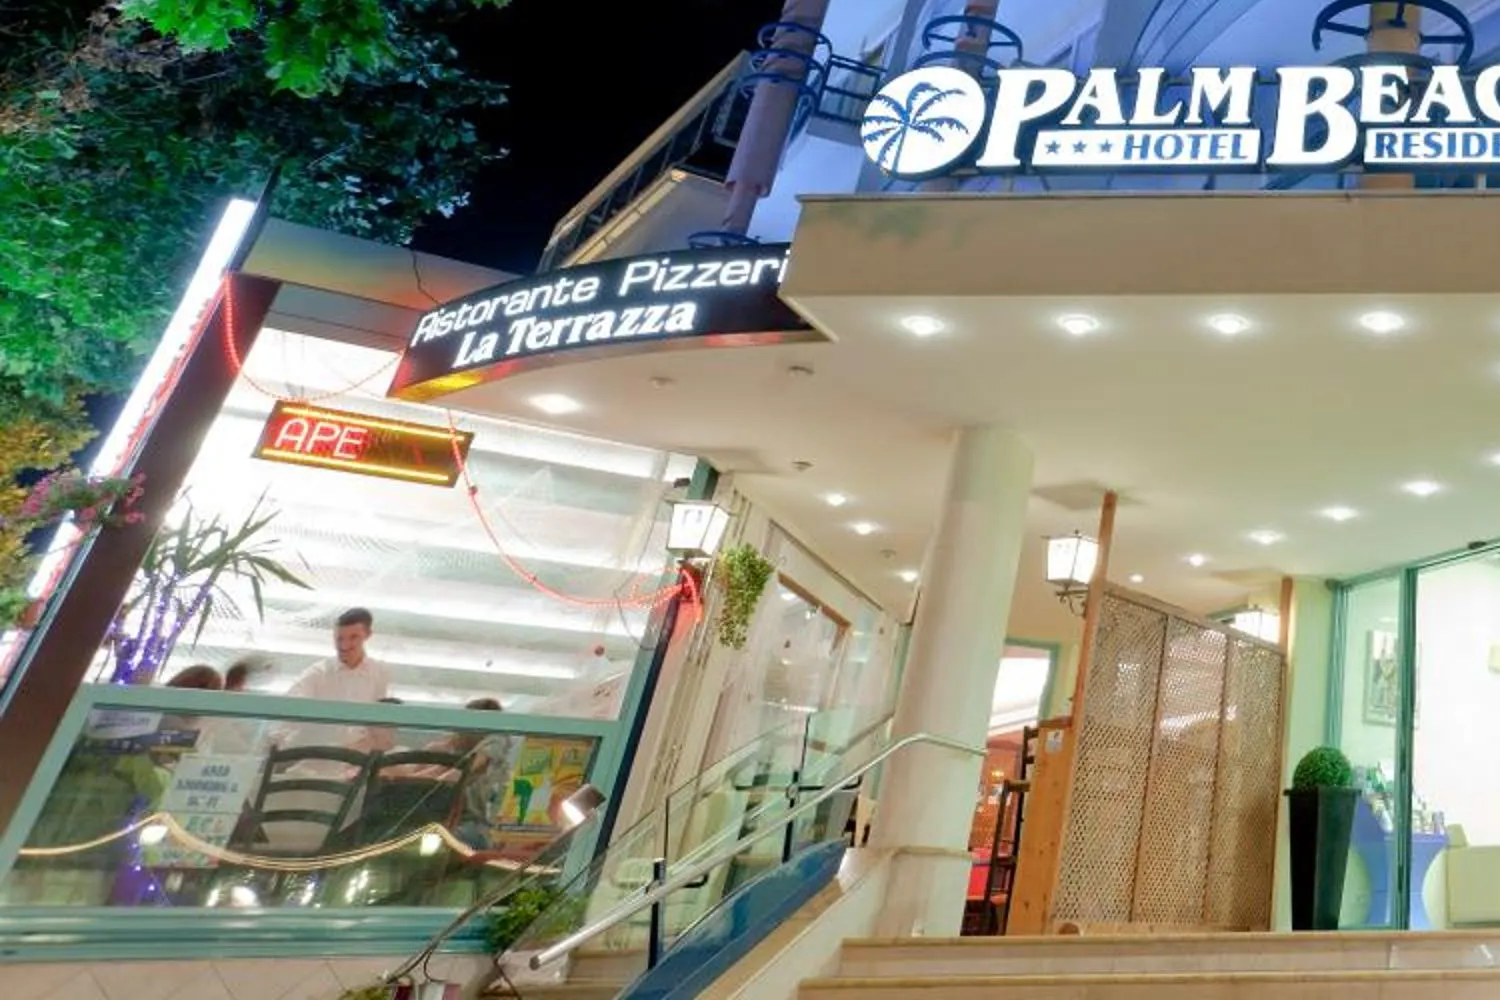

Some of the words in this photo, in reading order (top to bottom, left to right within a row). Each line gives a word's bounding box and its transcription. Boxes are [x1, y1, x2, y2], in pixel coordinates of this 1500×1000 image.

[975, 67, 1256, 168] PALM
[1122, 133, 1249, 160] HOTEL
[453, 326, 497, 369] La
[506, 302, 697, 354] Terrazza
